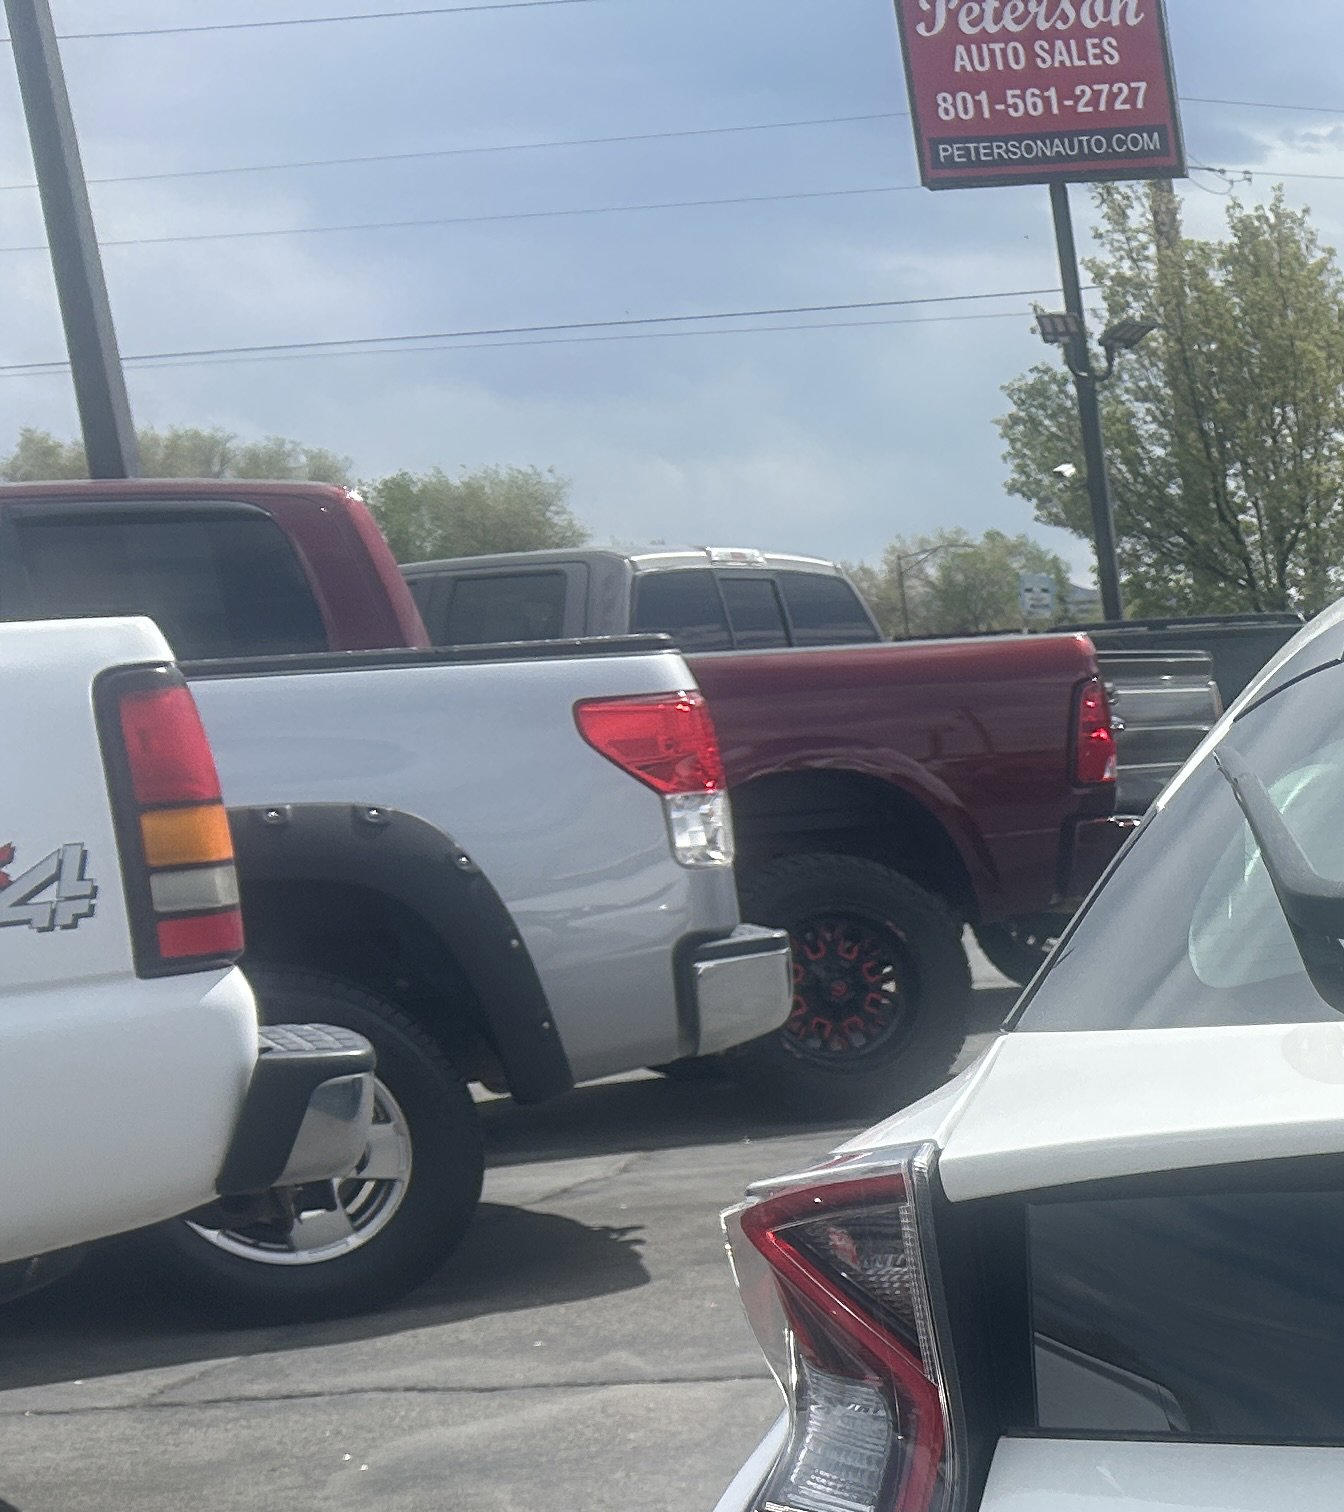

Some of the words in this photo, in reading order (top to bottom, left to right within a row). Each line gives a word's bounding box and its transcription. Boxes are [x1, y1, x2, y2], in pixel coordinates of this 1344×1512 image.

[953, 41, 1026, 72] AUTO
[1035, 36, 1120, 69] SALES
[936, 81, 1148, 121] 801-561-2727
[938, 132, 1160, 163] PETERSONAUTO.COM
